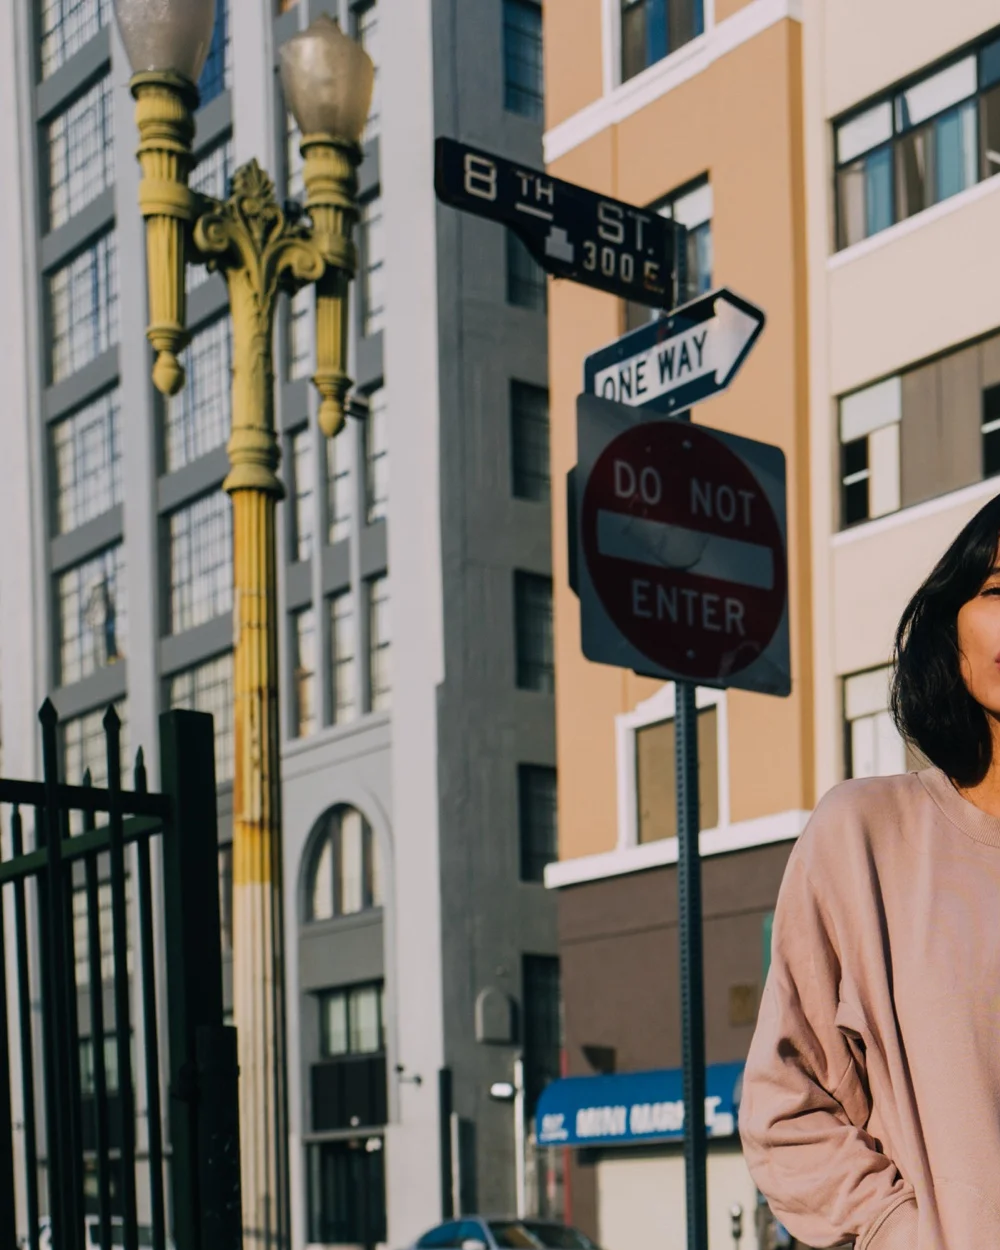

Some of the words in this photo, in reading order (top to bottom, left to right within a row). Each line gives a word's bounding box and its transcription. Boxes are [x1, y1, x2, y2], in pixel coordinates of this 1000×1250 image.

[582, 240, 634, 283] 300
[602, 359, 648, 401] ONE
[657, 331, 708, 385] WAY
[614, 460, 662, 504] DO
[690, 477, 756, 526] NOT
[632, 578, 745, 635] ENTER
